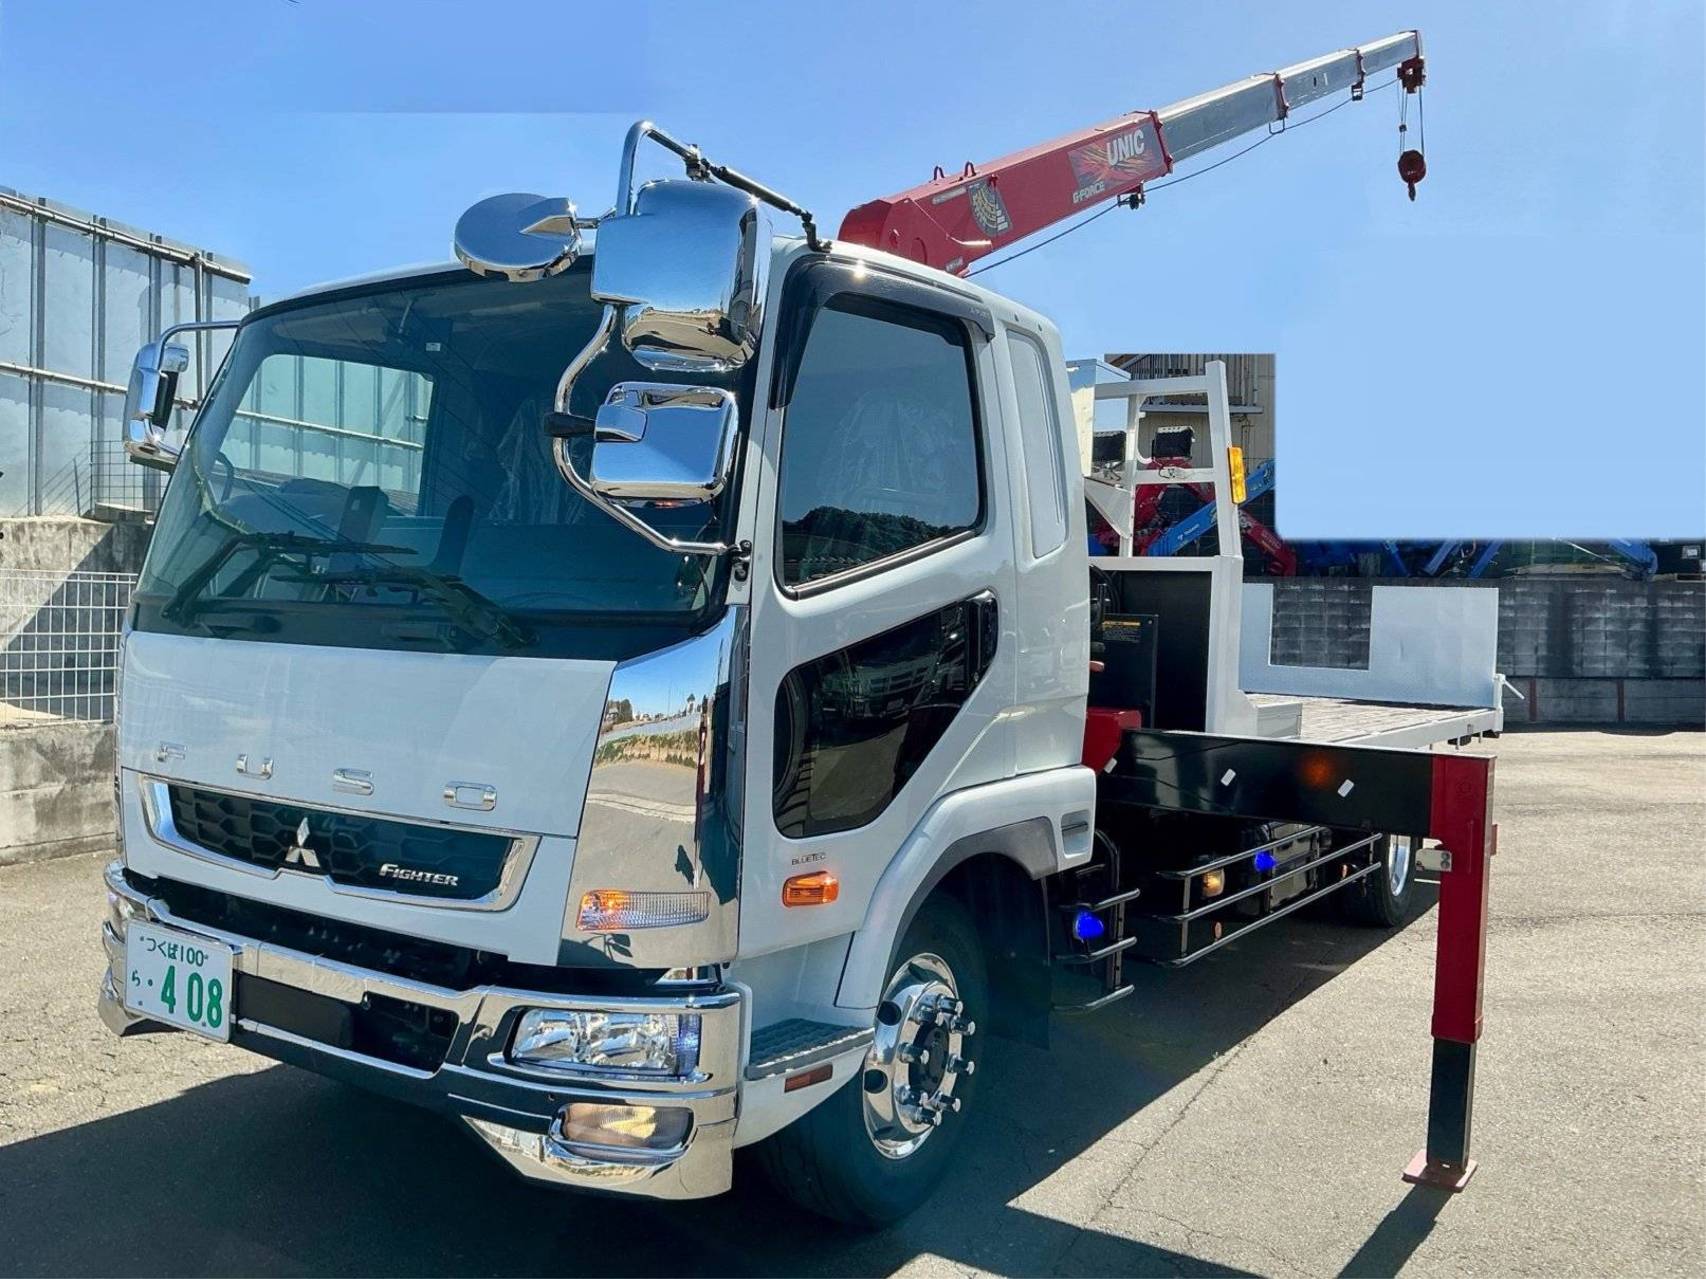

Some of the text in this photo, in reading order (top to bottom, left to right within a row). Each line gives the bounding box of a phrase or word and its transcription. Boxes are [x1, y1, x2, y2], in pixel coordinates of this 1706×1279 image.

[1106, 129, 1145, 166] UNIC
[154, 740, 498, 812] FUSO
[791, 852, 826, 866] BLUETEC
